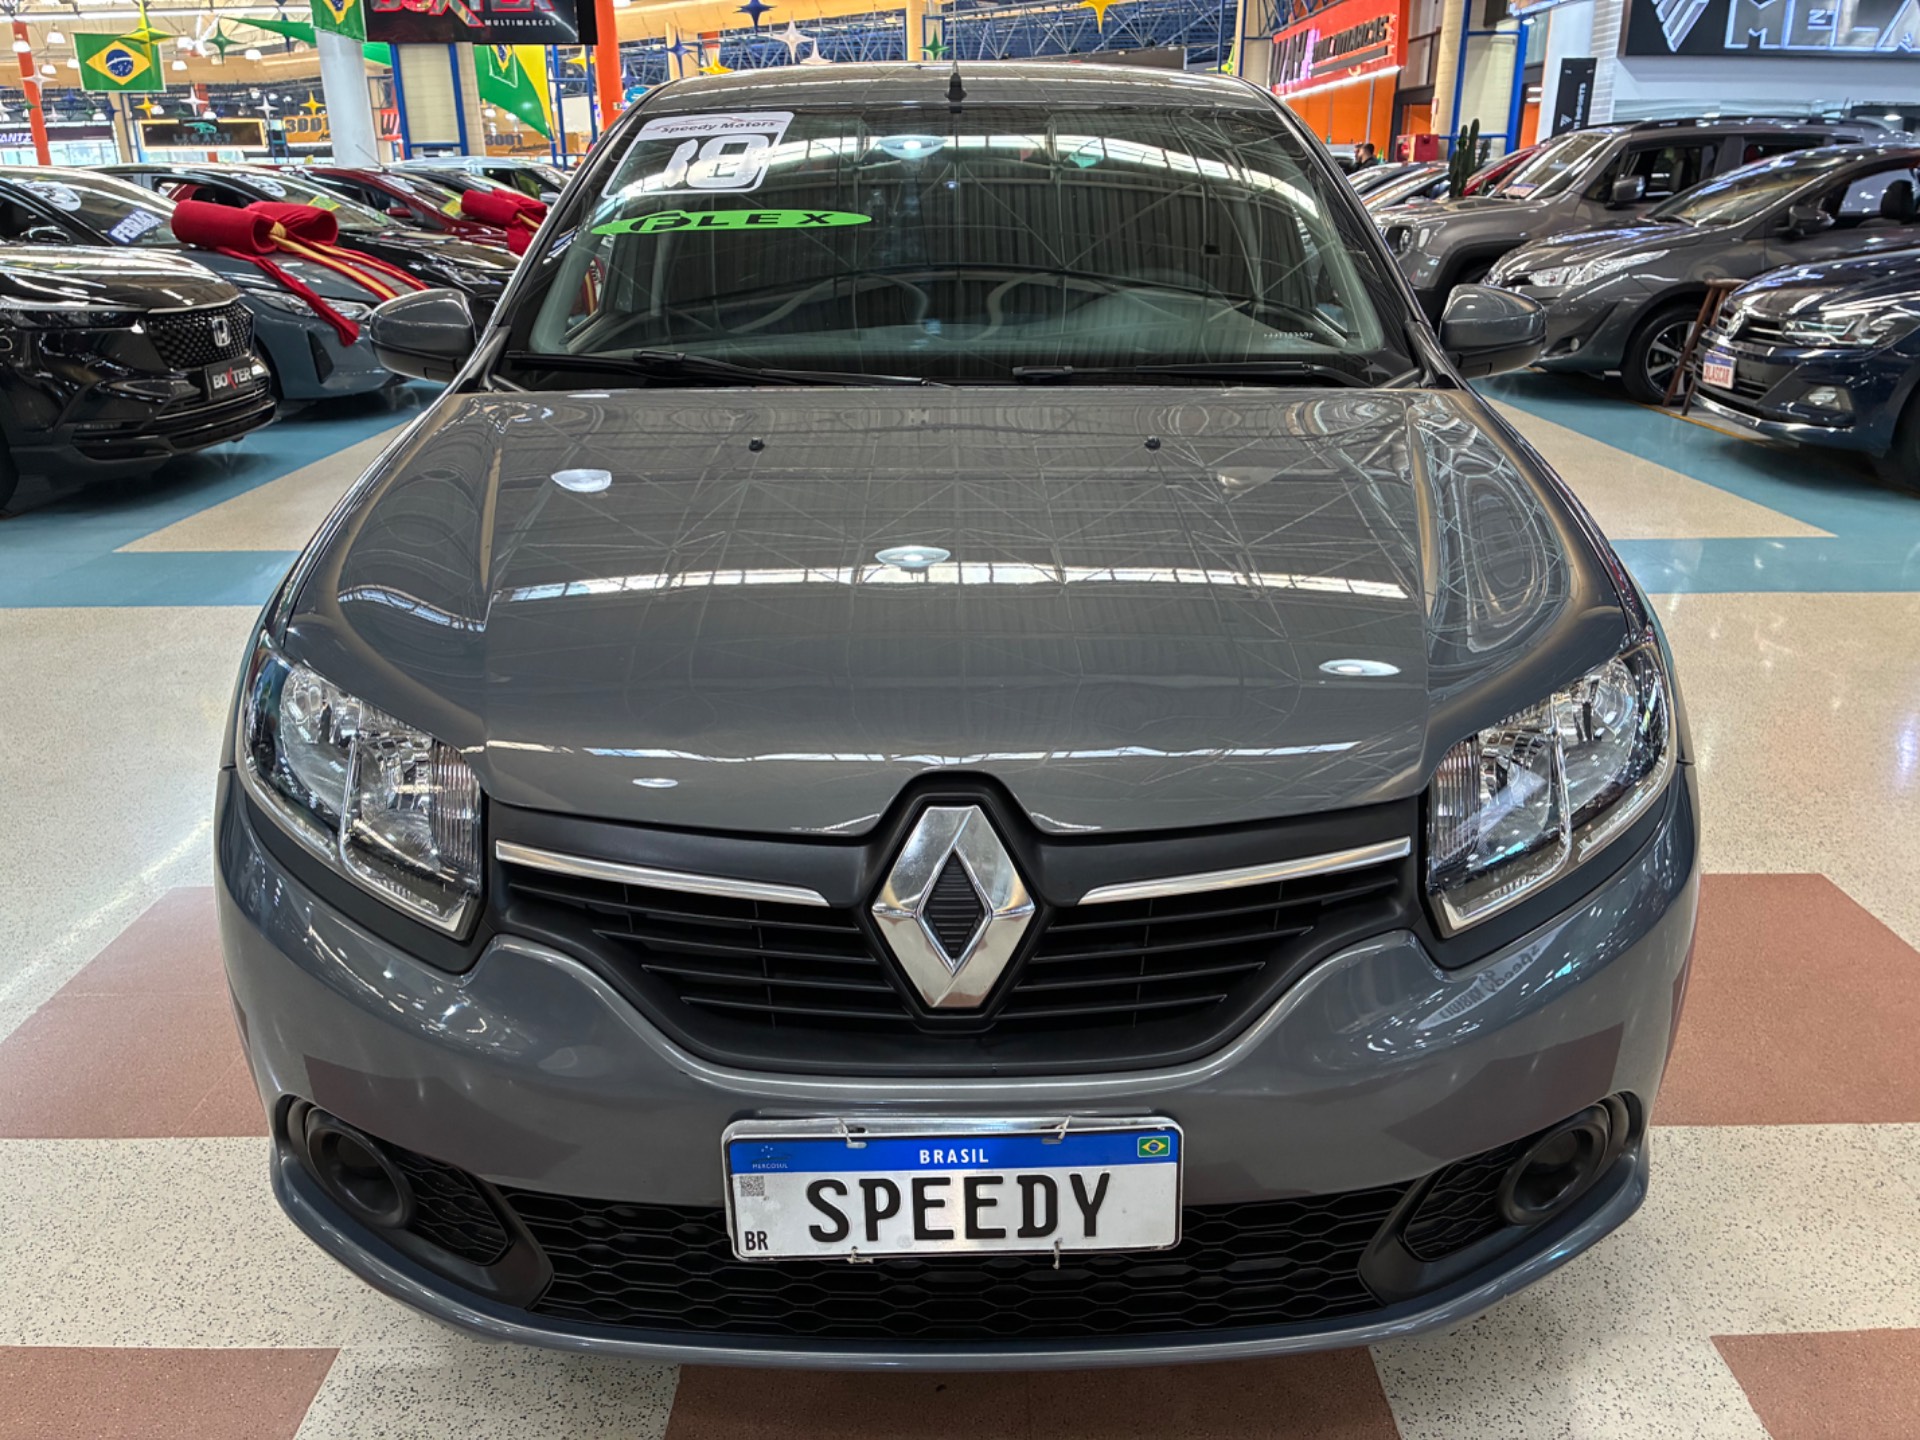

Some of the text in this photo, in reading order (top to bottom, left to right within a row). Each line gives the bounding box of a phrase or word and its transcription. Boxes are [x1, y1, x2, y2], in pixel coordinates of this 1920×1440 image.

[484, 19, 557, 27] MULTIMARCAS
[661, 121, 776, 134] Speedy Motors
[172, 132, 232, 144] LEGACY
[662, 134, 770, 188] 18
[630, 212, 834, 233] FLEX
[919, 1149, 990, 1165] BRASIL
[806, 1172, 1110, 1243] SPEEDY
[744, 1231, 769, 1251] BR
